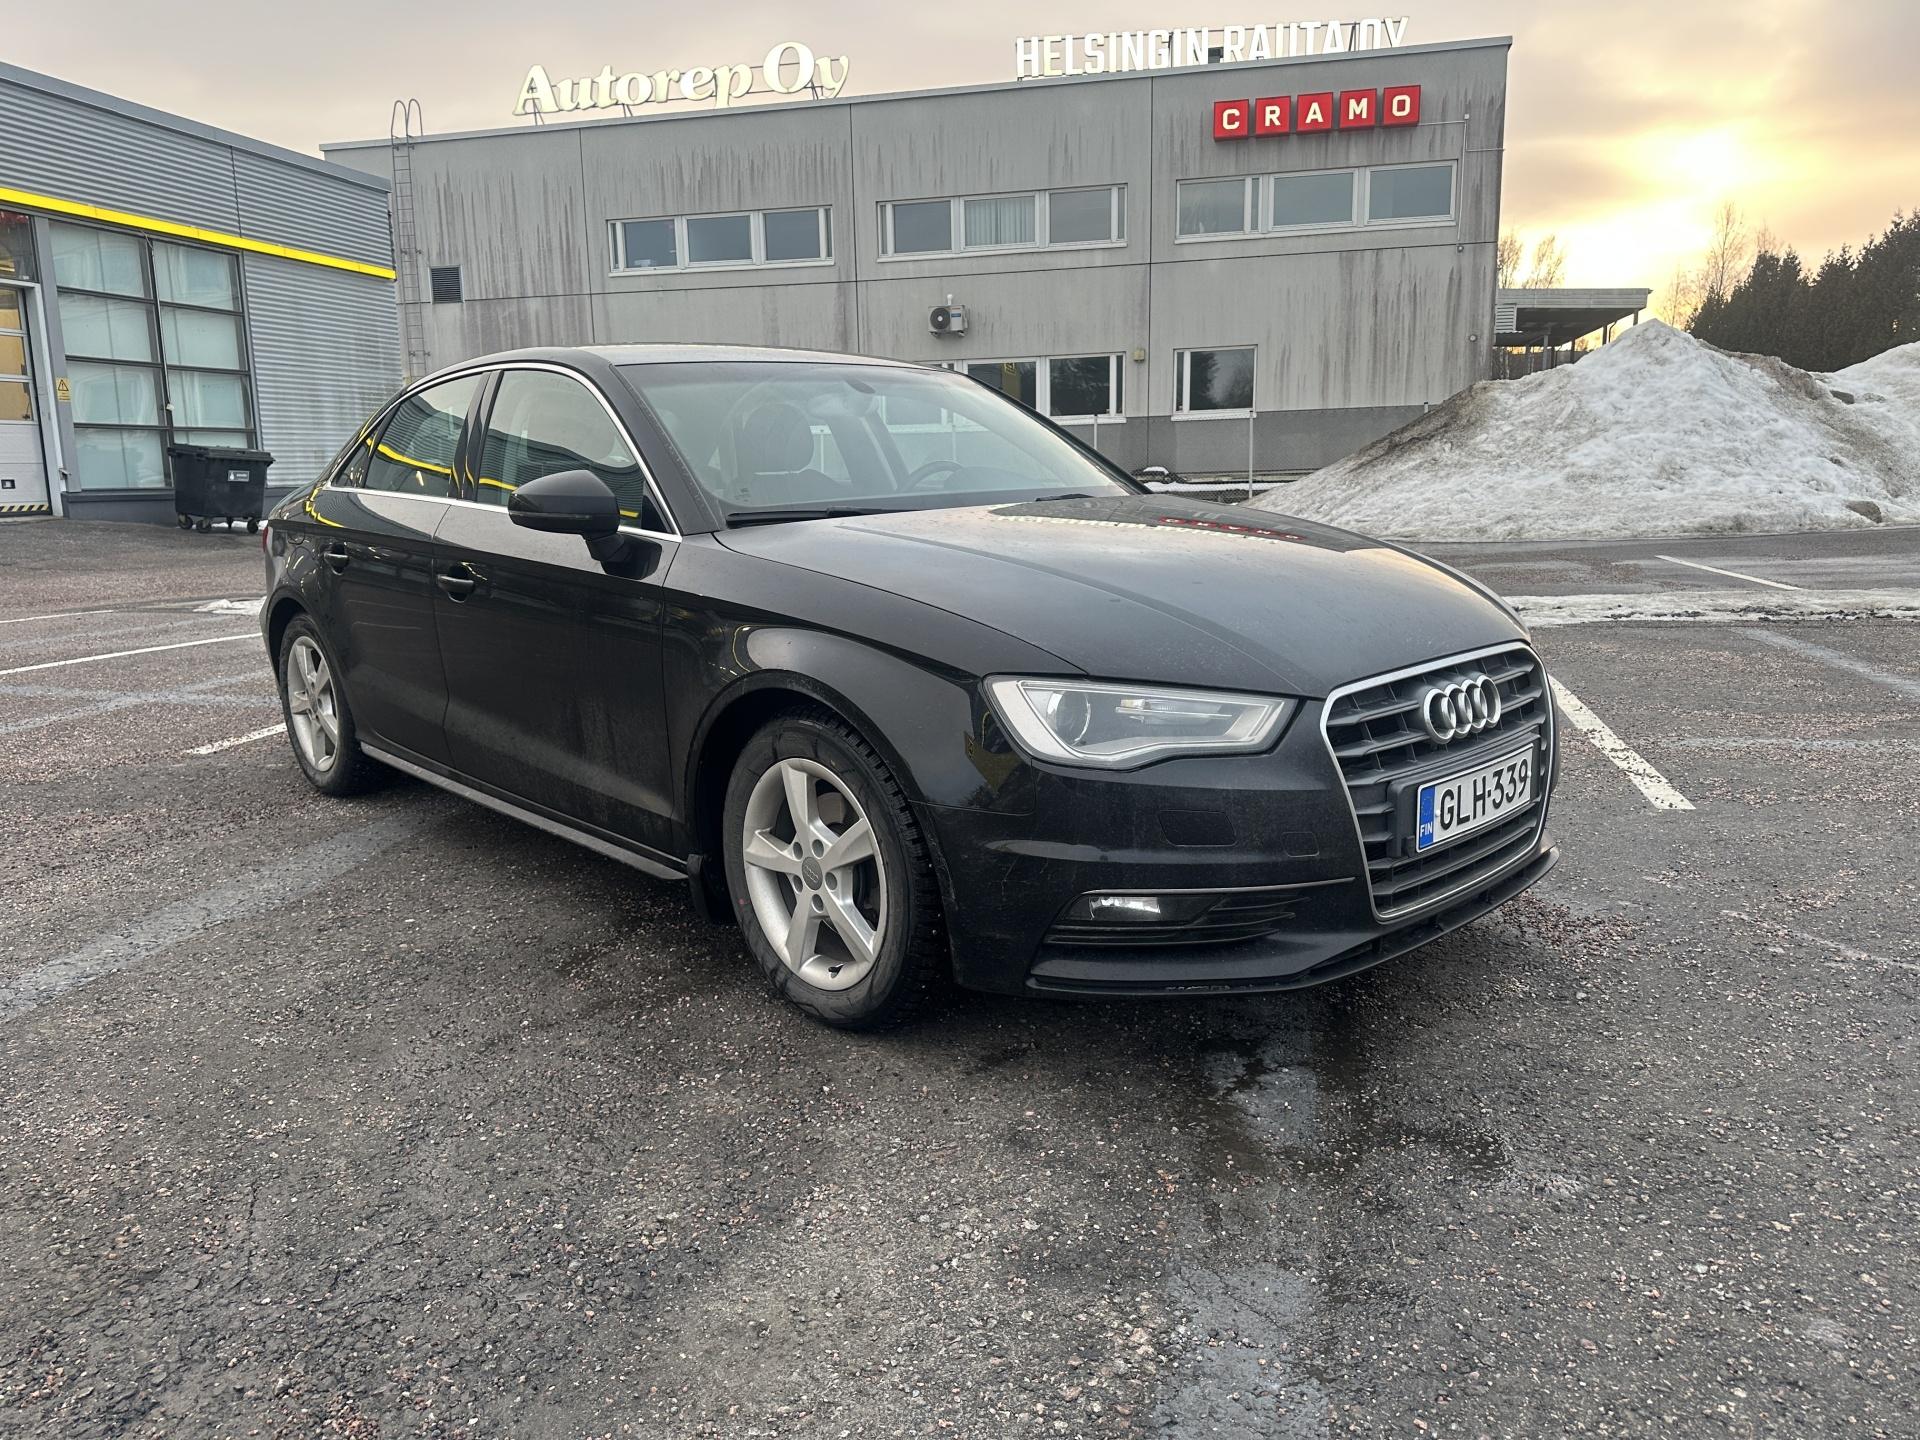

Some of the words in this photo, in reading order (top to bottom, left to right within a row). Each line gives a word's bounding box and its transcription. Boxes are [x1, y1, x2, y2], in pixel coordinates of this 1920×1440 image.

[512, 64, 754, 115] Autorep
[763, 41, 850, 99] Oy
[1016, 26, 1209, 79] HELSINGIN
[1223, 20, 1346, 63] RAUTA
[1359, 16, 1410, 51] OY
[1222, 94, 1411, 130] CRAMO
[1439, 758, 1528, 830] GLH-339
[1420, 822, 1433, 838] FIN
